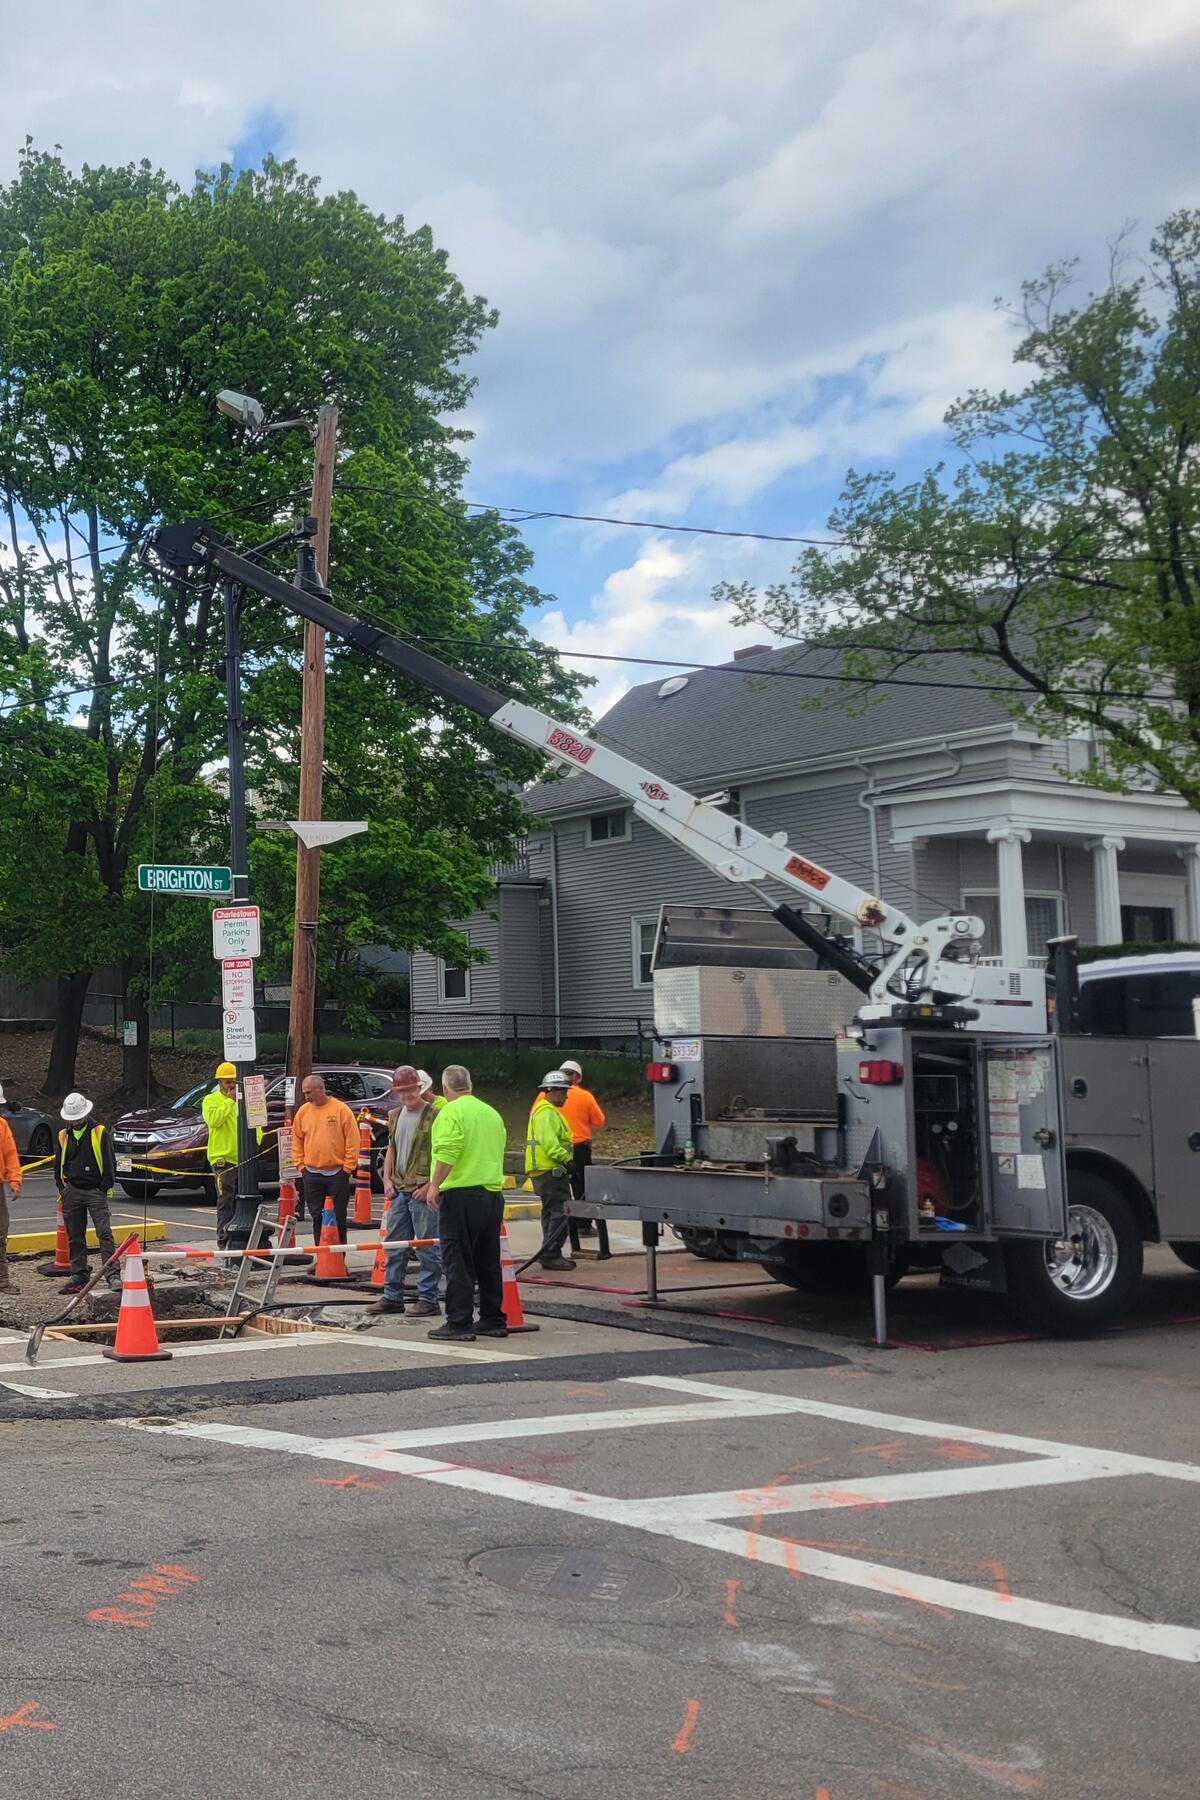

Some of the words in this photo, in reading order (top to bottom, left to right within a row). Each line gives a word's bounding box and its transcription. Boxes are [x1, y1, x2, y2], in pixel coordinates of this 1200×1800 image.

[549, 731, 593, 762] 3820
[640, 782, 669, 800] IMT
[147, 869, 213, 889] BRIGHTON
[214, 880, 224, 890] ST
[216, 910, 256, 919] Charlestown
[223, 920, 248, 928] Permit
[222, 929, 251, 937] Parking
[227, 937, 246, 945] Only
[224, 961, 235, 969] TOW
[236, 960, 251, 968] ZONE
[226, 1026, 245, 1034] Street
[226, 1033, 253, 1041] Cleaning
